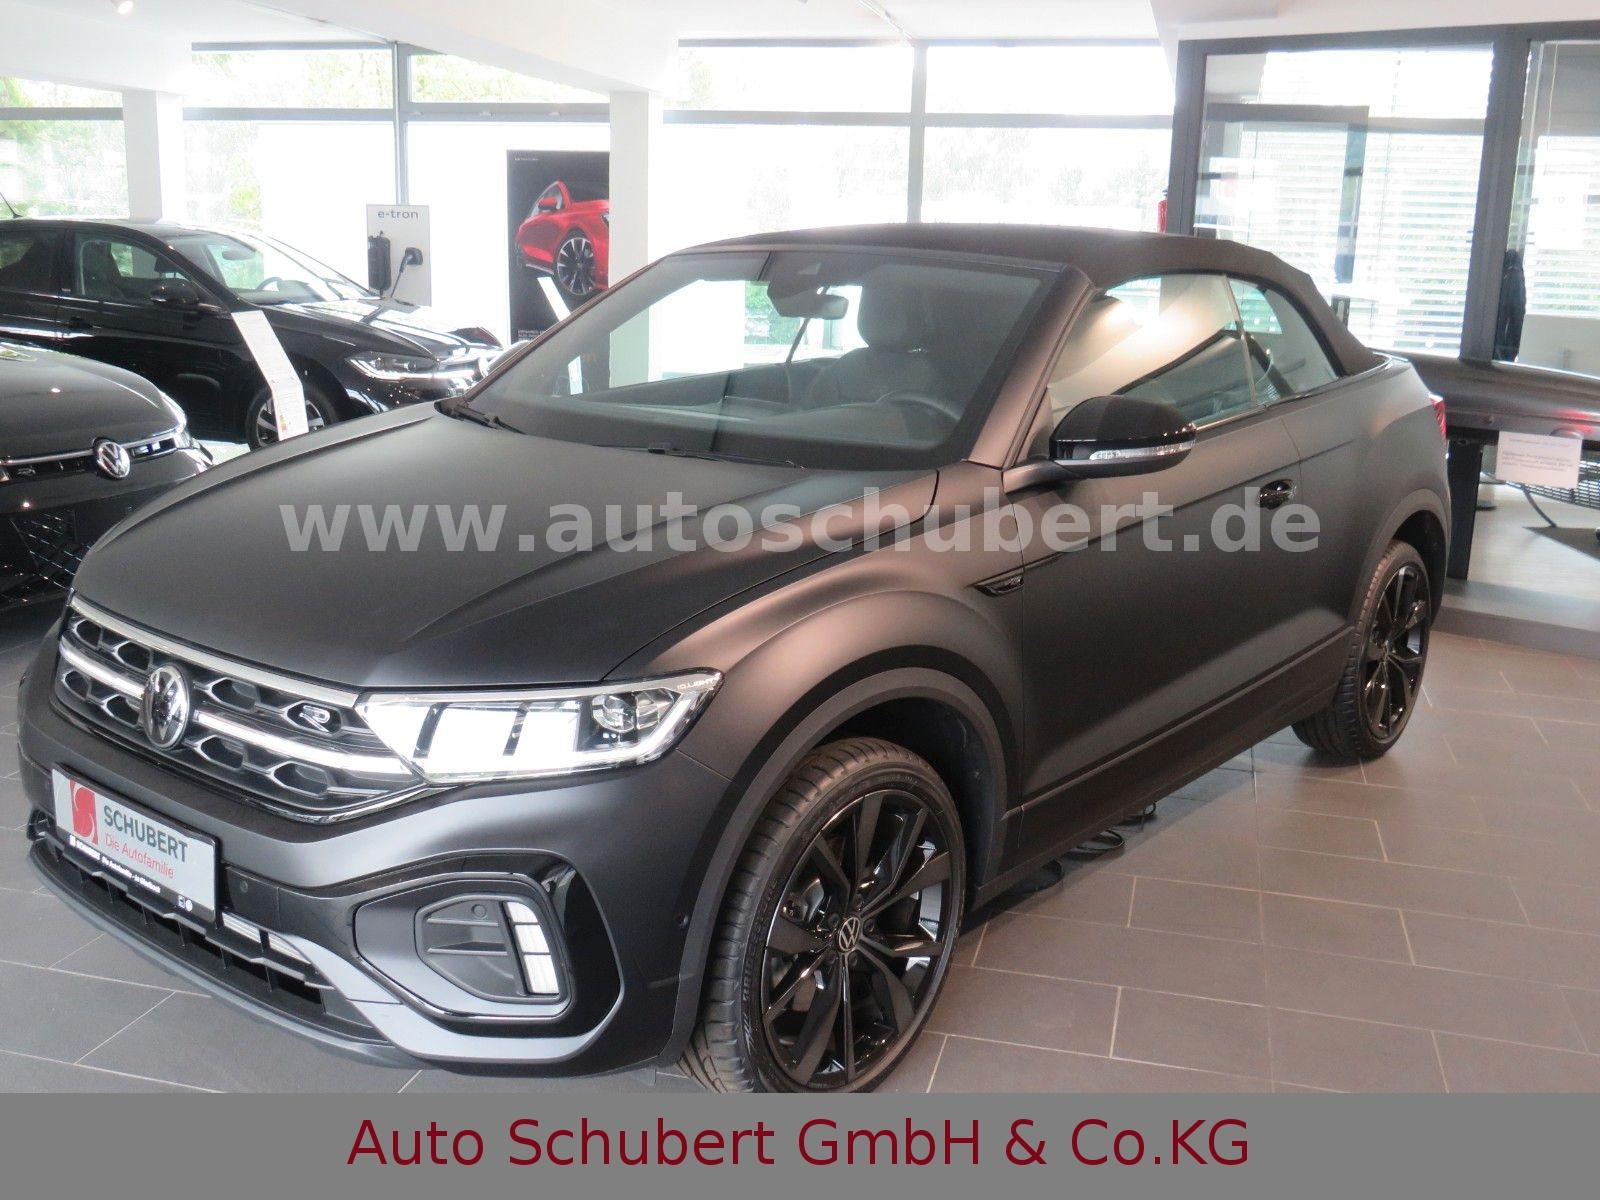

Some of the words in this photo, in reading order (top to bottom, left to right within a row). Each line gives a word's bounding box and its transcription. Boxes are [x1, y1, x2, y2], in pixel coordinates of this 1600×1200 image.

[377, 210, 419, 219] e-tron
[103, 805, 188, 863] SCHUBERT
[105, 833, 120, 852] Die
[122, 844, 174, 879] Autofamilie
